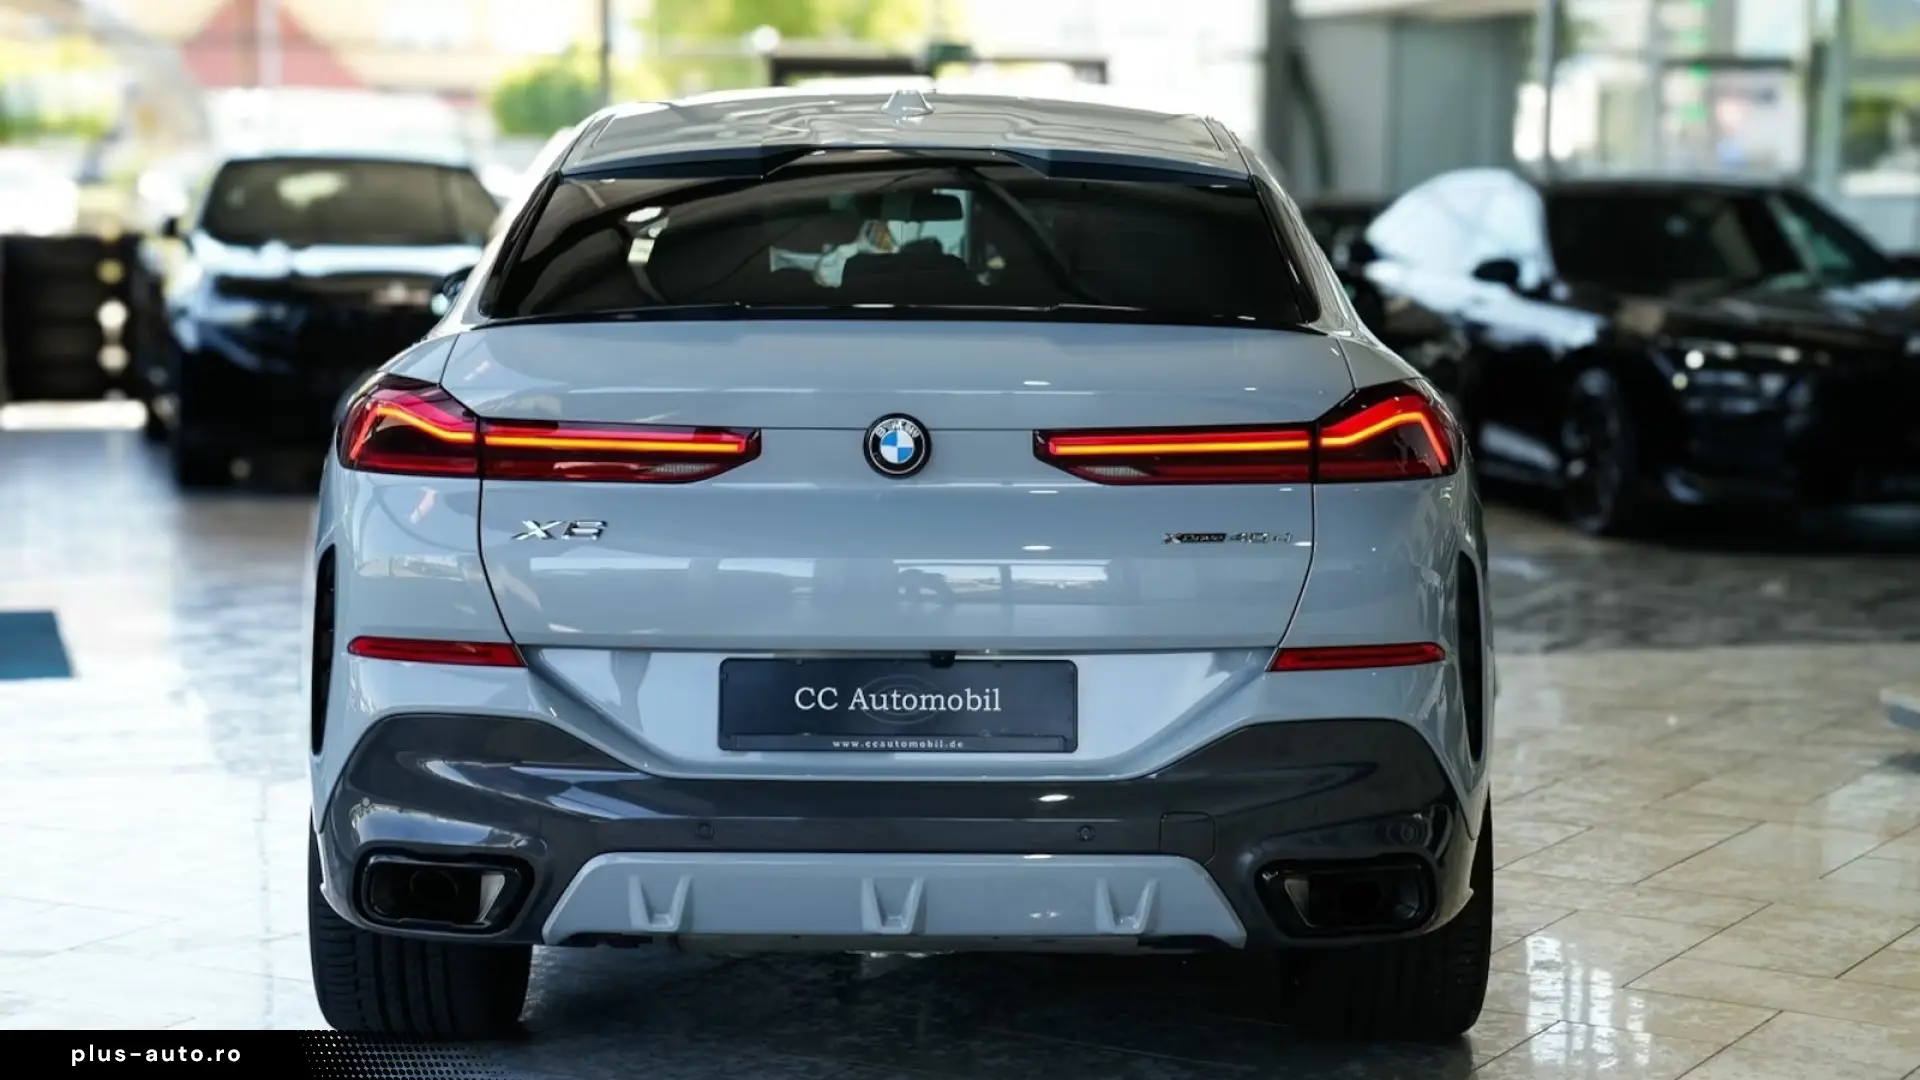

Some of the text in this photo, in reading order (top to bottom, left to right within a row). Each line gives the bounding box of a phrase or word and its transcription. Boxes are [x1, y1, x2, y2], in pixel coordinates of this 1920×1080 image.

[794, 686, 1002, 712] CC Automobil
[832, 739, 963, 749] www.ccautomobil.de
